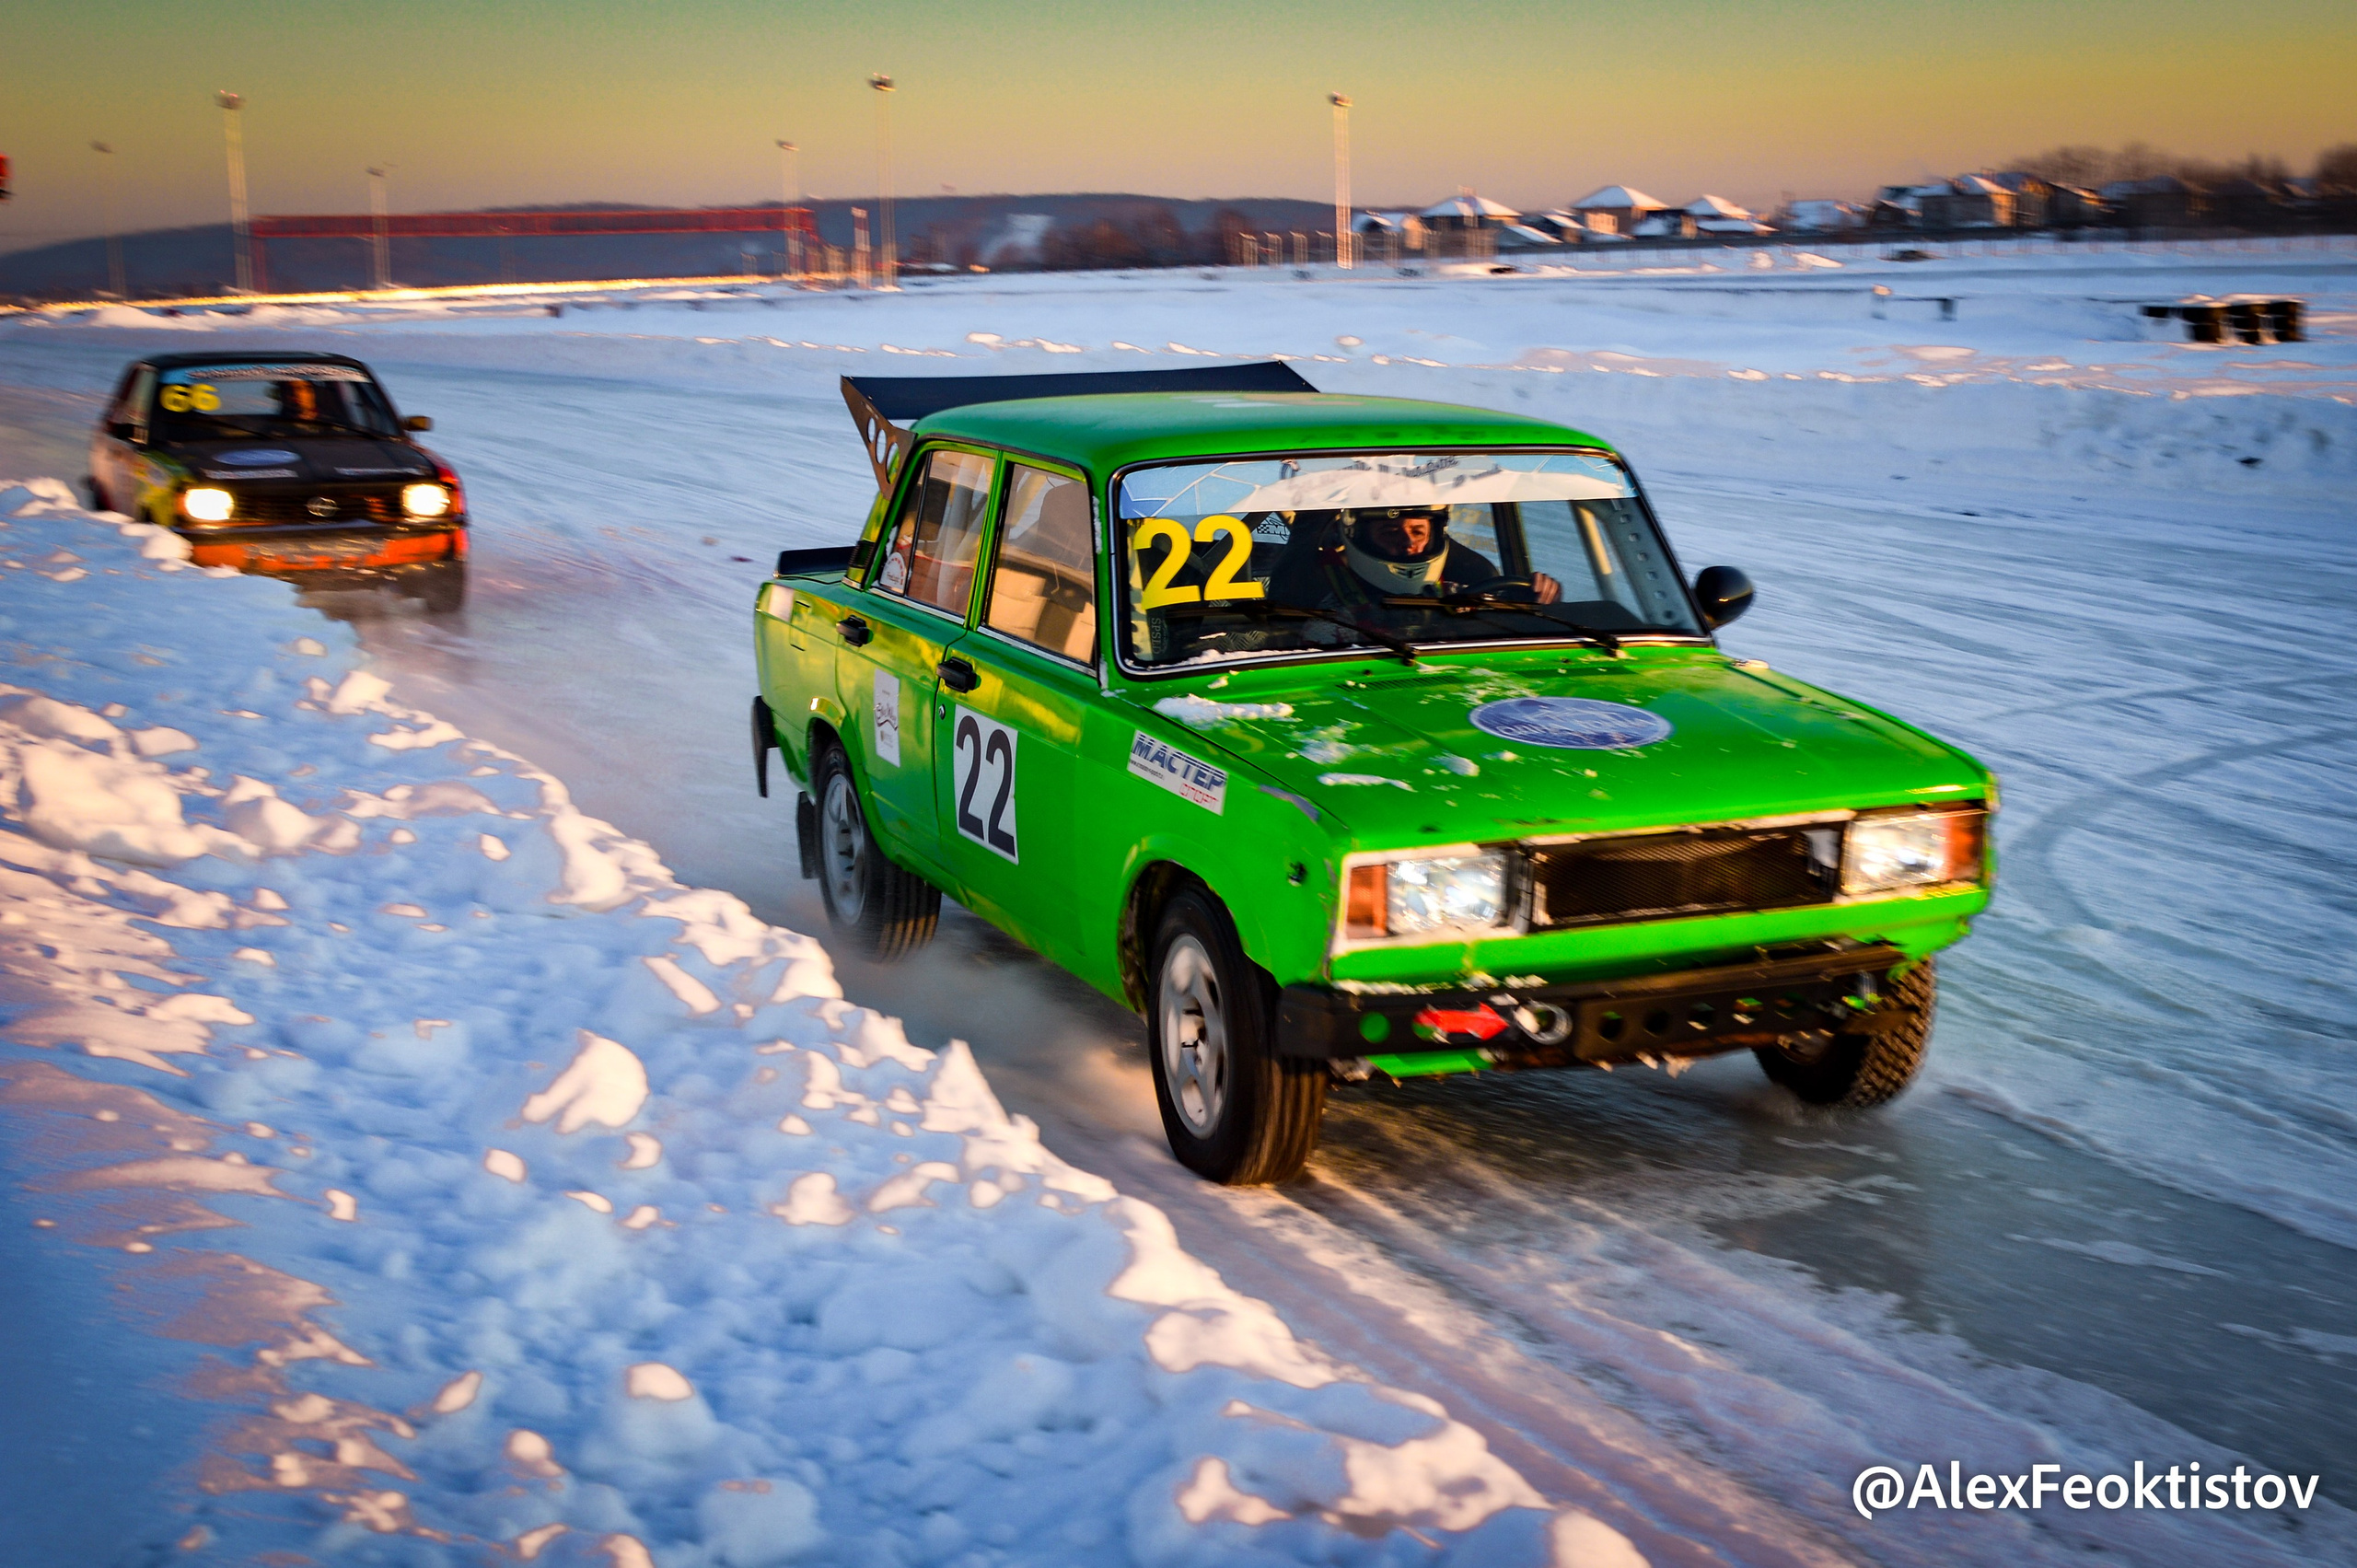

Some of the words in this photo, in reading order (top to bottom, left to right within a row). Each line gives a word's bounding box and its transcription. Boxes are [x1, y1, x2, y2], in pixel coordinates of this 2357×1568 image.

[160, 383, 221, 412] 66
[1133, 515, 1265, 610] 22
[956, 714, 1016, 858] 22
[1132, 733, 1227, 792] МАСТЕР
